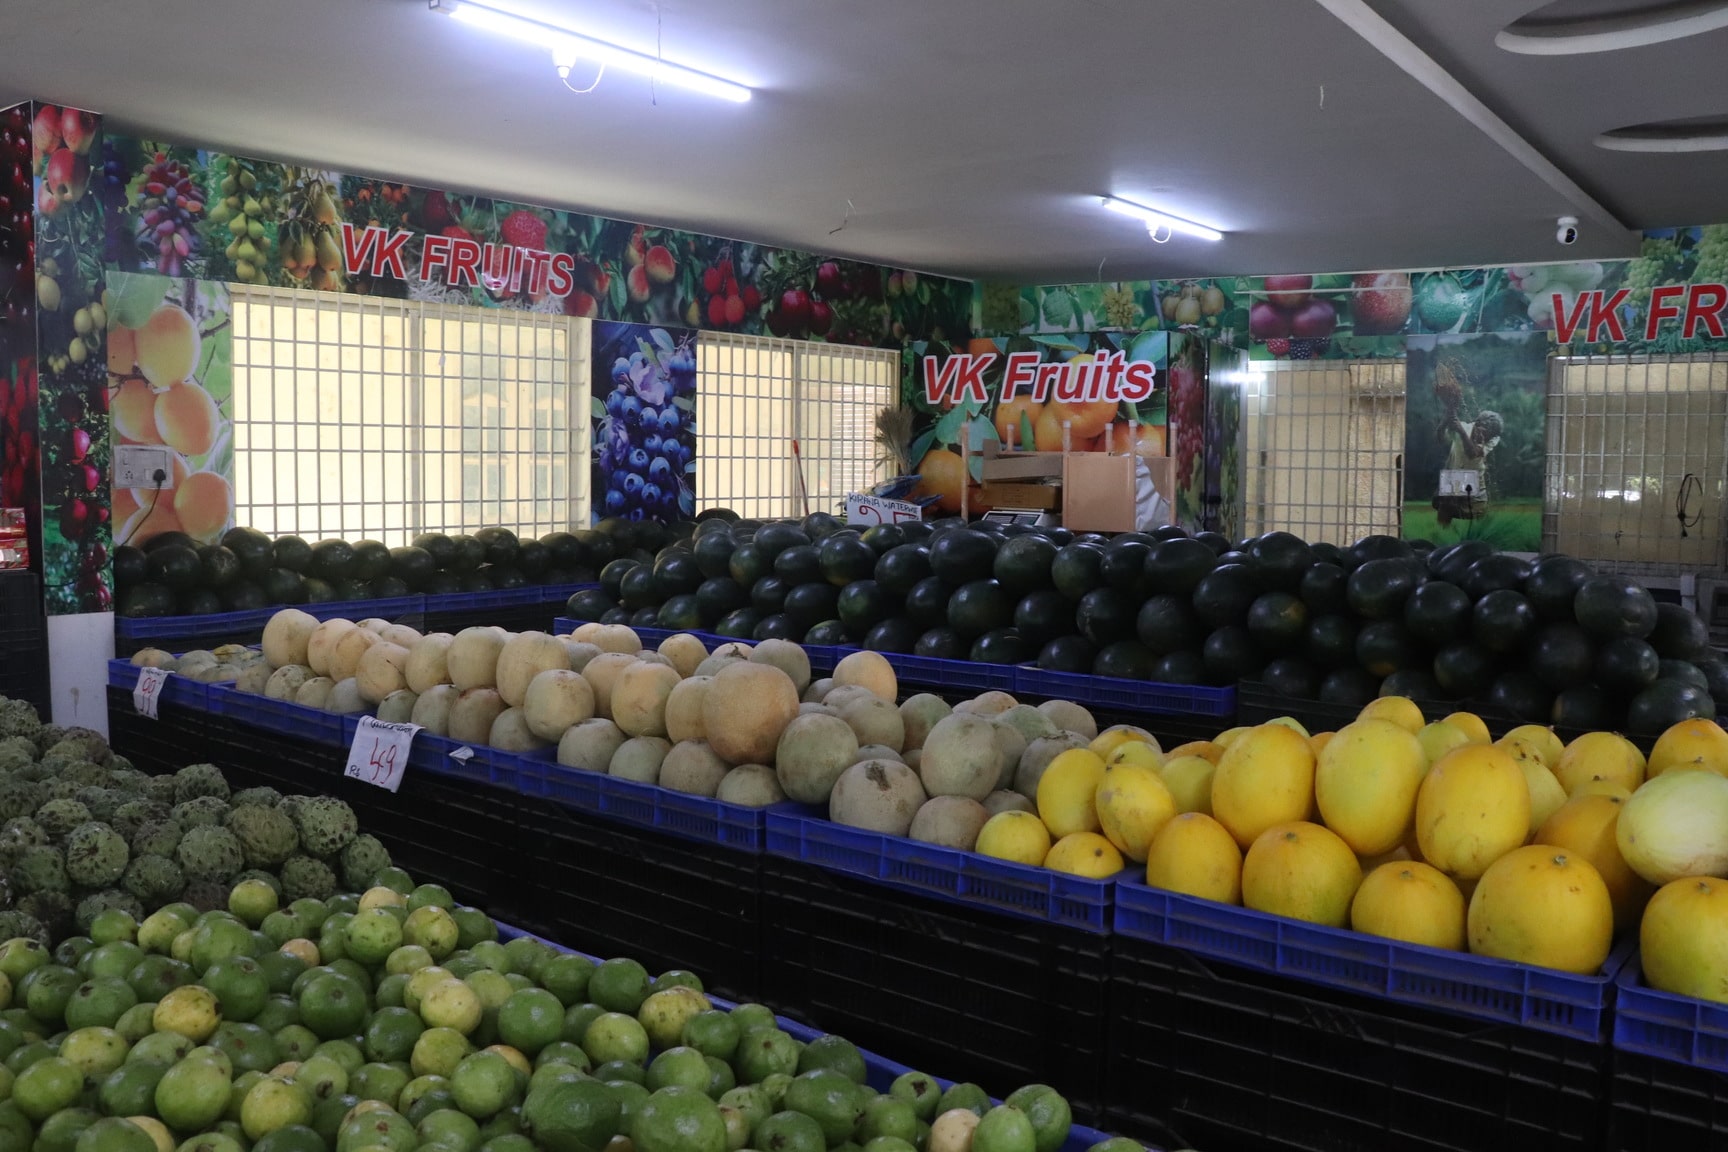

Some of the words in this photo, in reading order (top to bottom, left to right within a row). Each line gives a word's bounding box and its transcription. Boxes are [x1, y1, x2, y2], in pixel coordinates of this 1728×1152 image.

[341, 222, 415, 280] VK
[419, 233, 575, 297] FRUITS
[1551, 288, 1632, 344] VK
[1644, 282, 1728, 341] FR
[923, 352, 997, 404] VK
[1000, 349, 1156, 403] Fruits
[369, 737, 397, 785] 49
